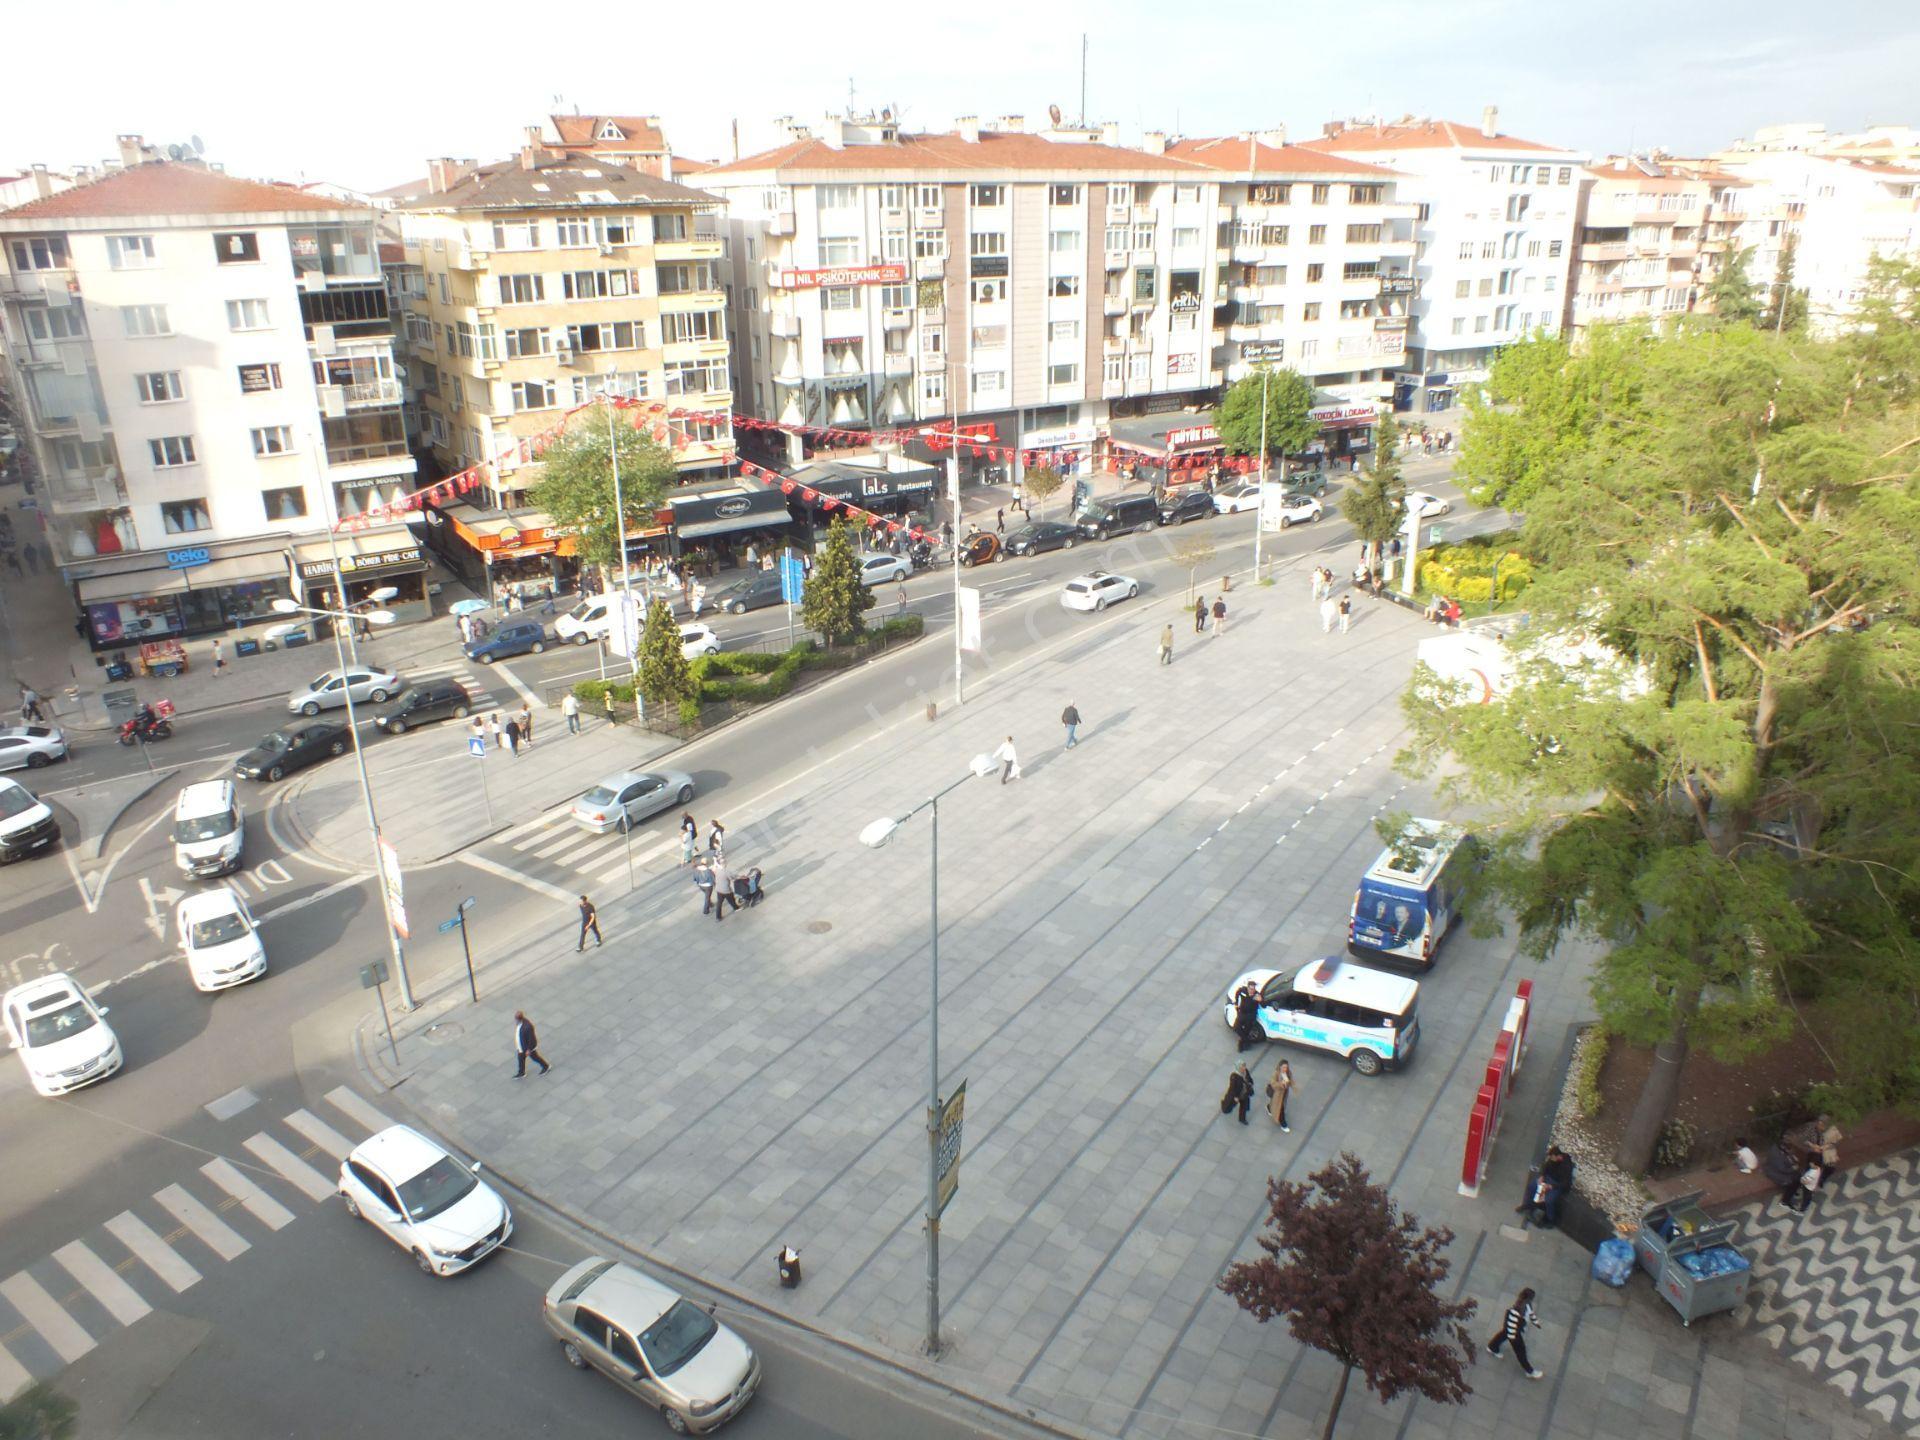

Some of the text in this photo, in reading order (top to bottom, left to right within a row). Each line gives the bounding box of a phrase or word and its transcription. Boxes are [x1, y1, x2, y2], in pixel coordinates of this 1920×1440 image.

[897, 480, 932, 491] Restaurant
[168, 548, 209, 563] beko
[402, 550, 420, 561] CAFE
